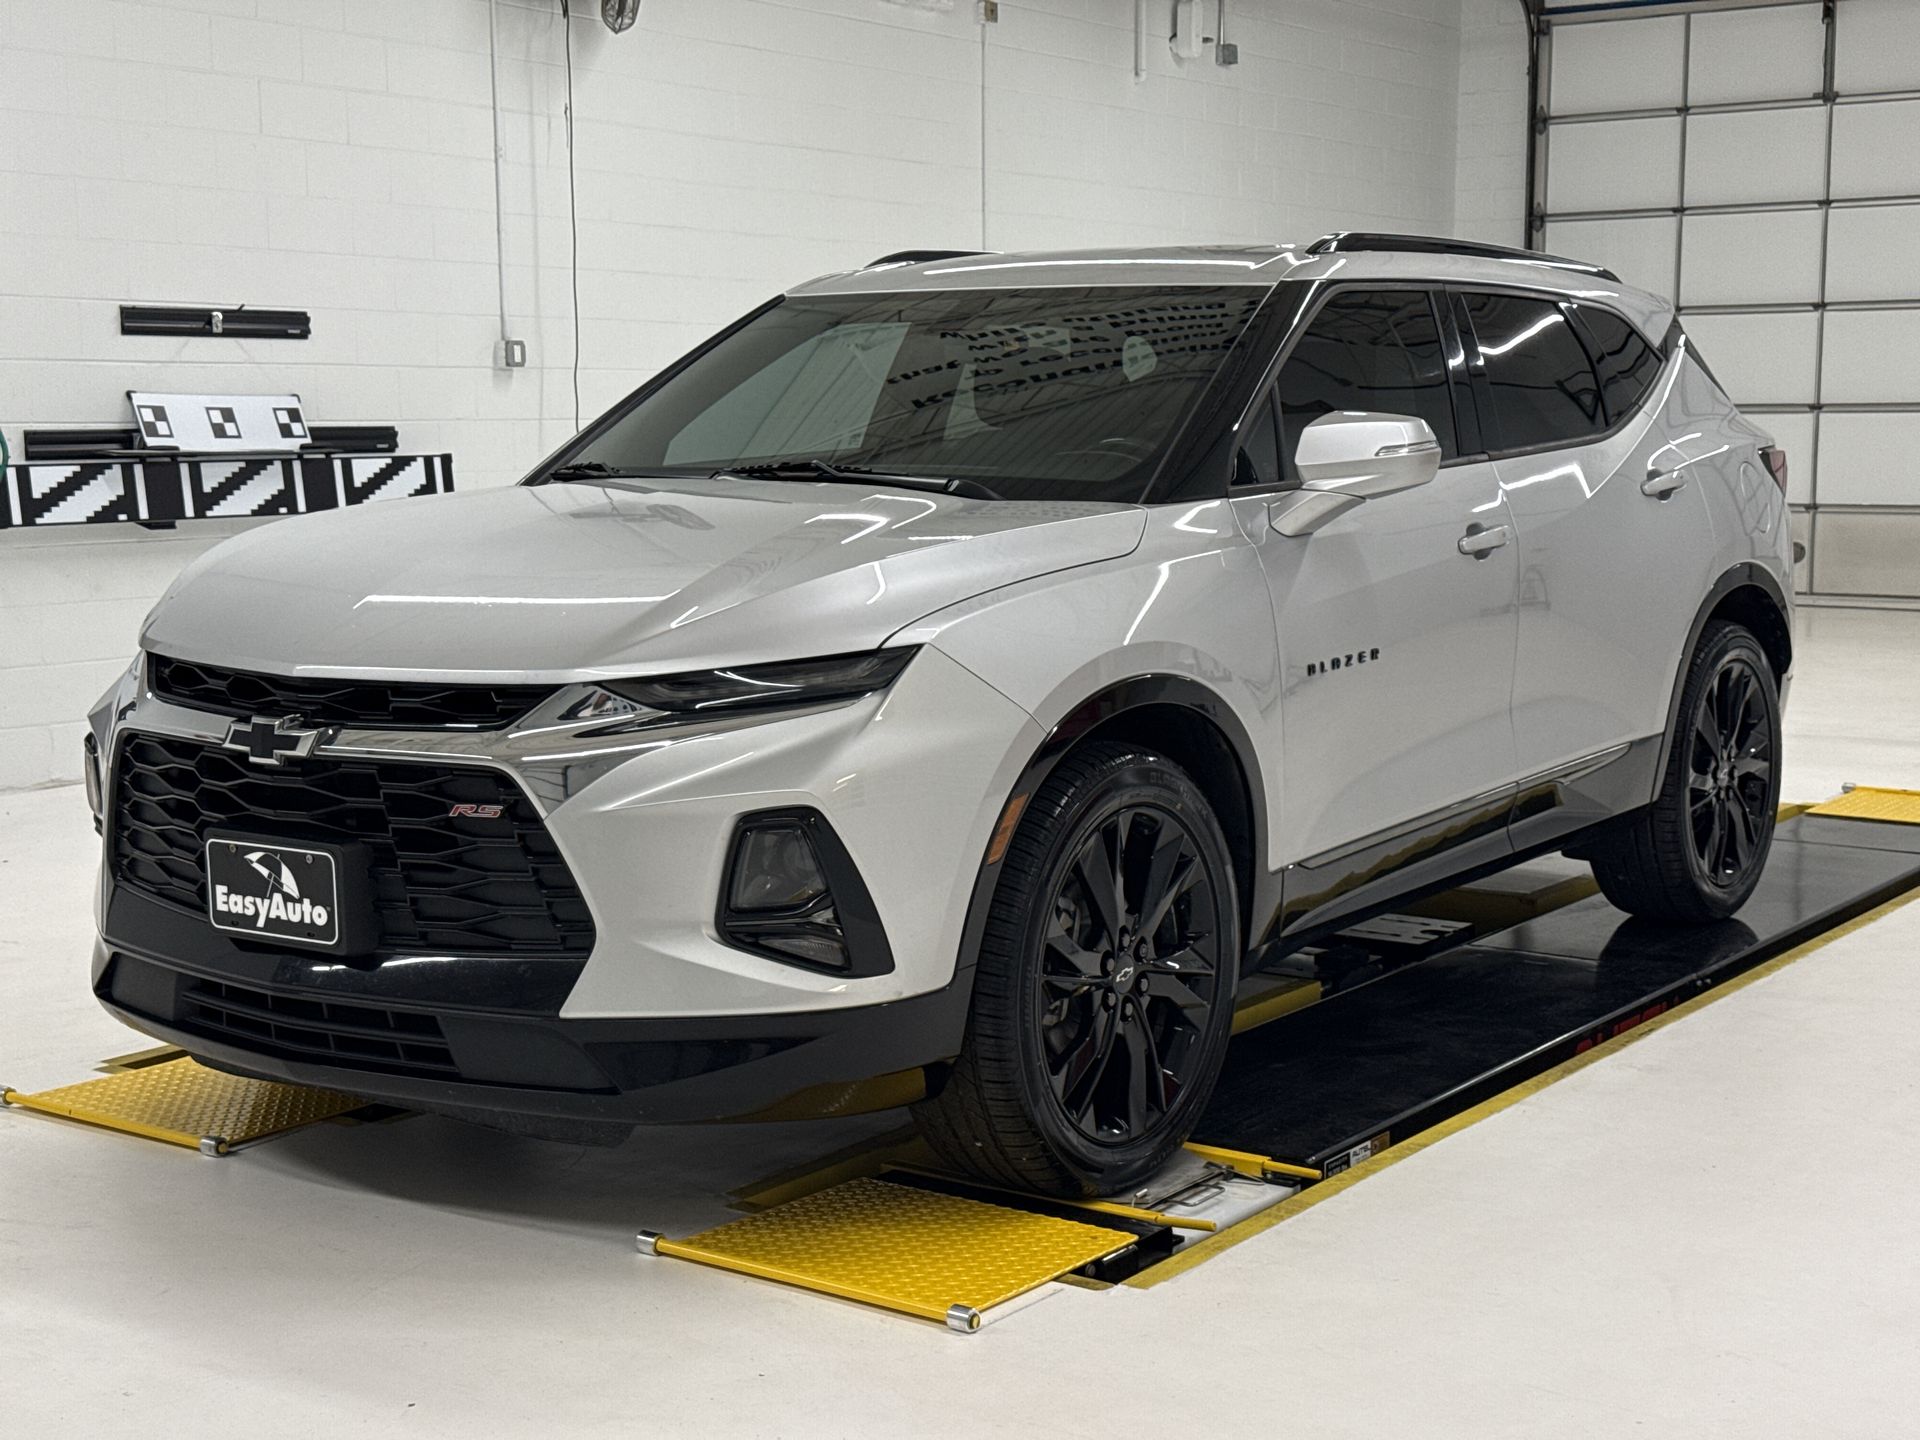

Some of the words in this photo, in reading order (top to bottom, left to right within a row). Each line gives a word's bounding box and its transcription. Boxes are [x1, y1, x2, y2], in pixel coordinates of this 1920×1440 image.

[1306, 647, 1380, 677] BLAZER
[448, 804, 504, 818] RS
[215, 884, 328, 928] EasyAuto
